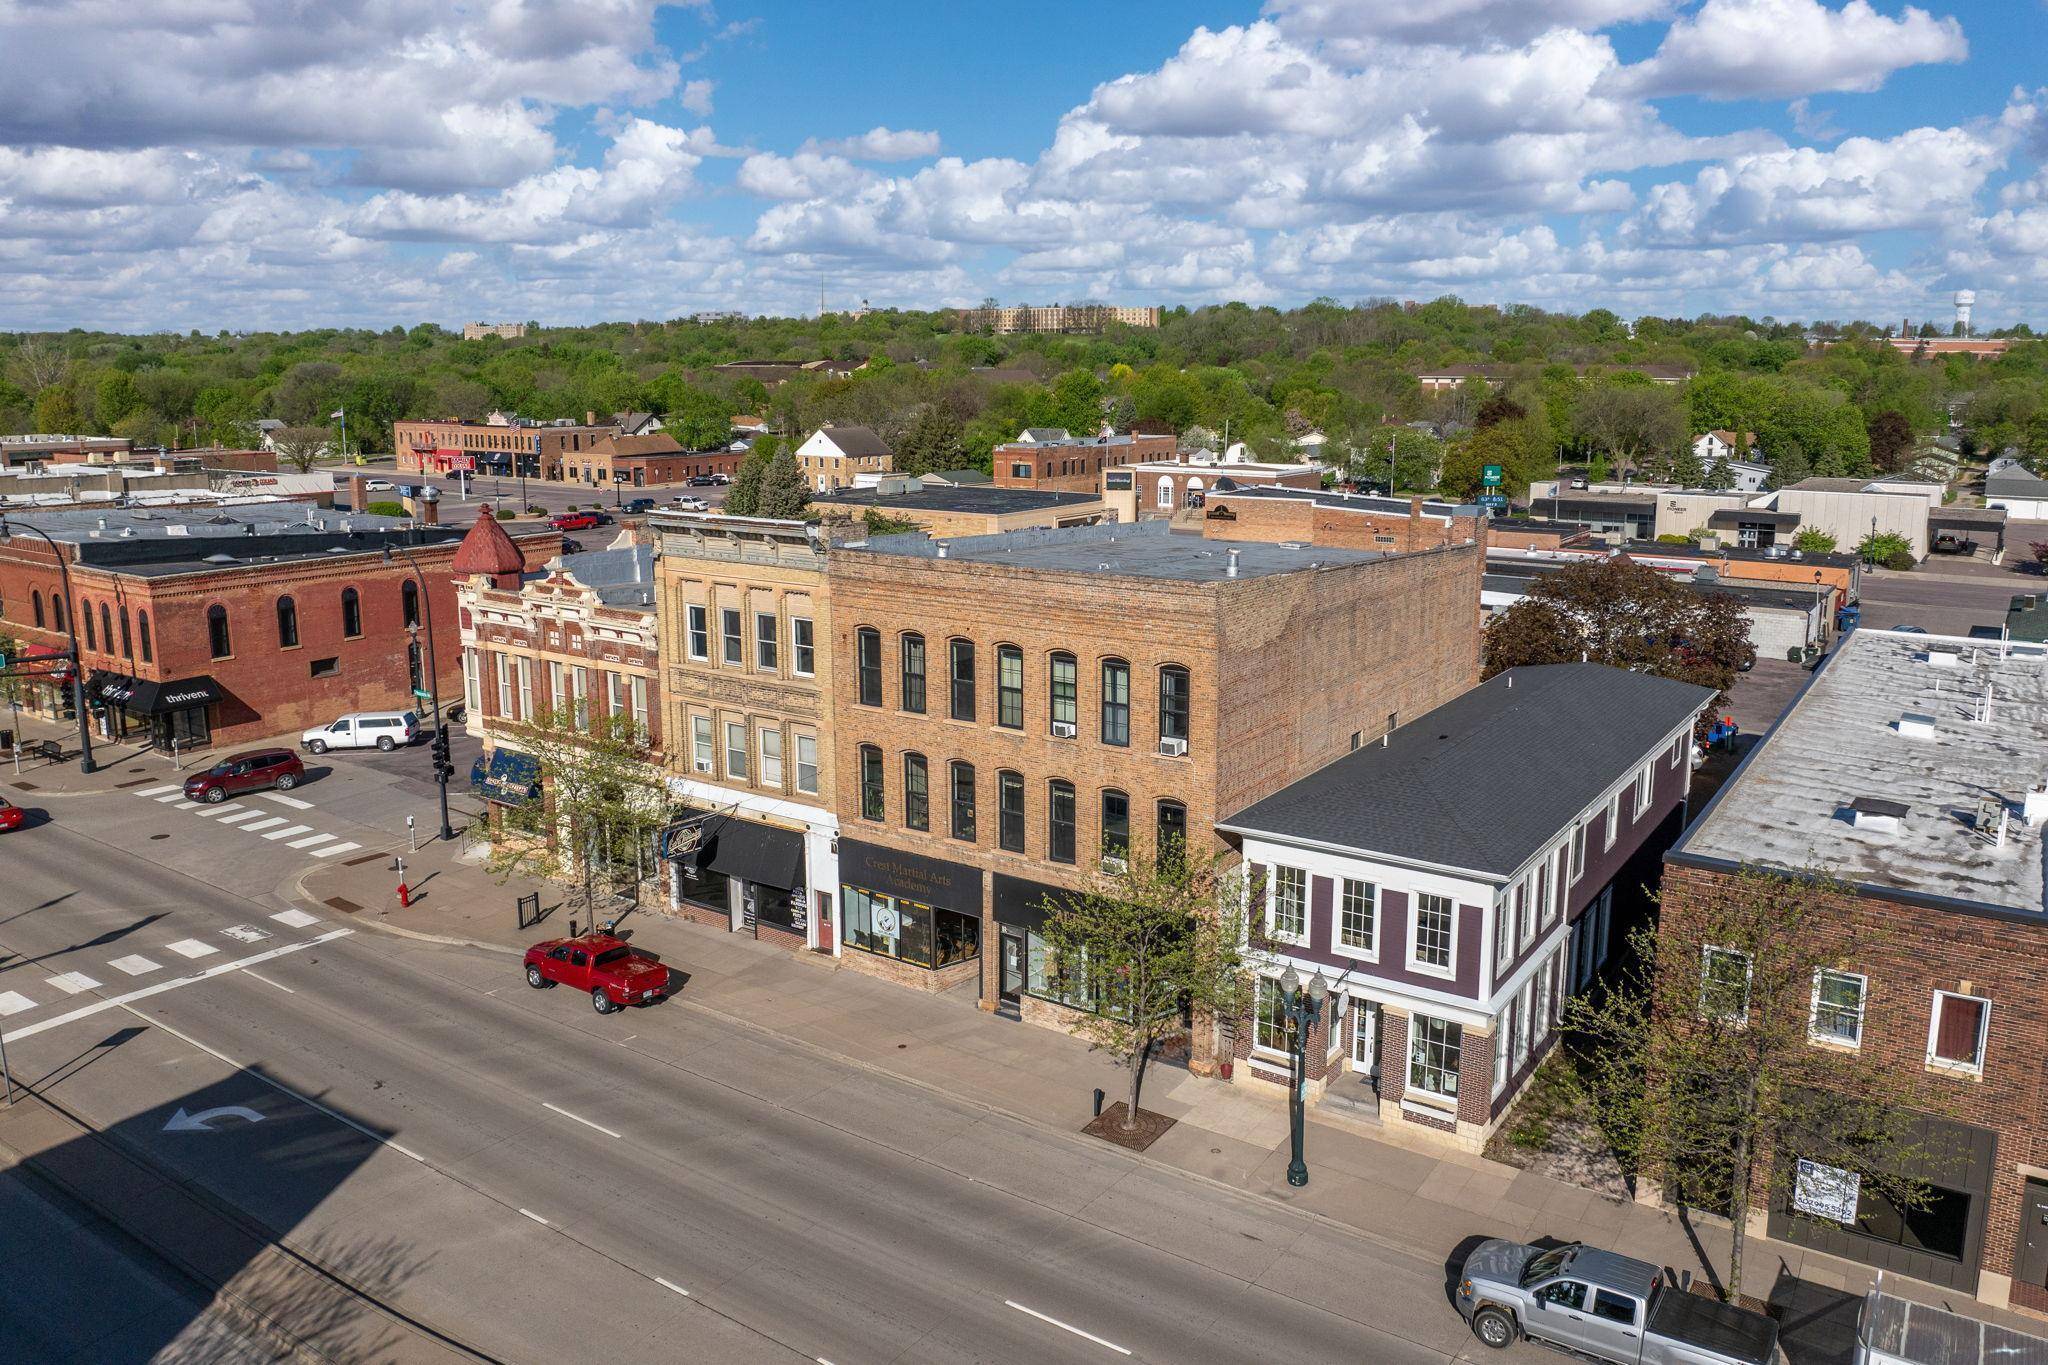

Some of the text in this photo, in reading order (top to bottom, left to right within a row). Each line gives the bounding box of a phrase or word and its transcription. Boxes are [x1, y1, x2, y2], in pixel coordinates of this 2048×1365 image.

[865, 856, 951, 887] Crest Martial Arts
[887, 874, 931, 895] Academy
